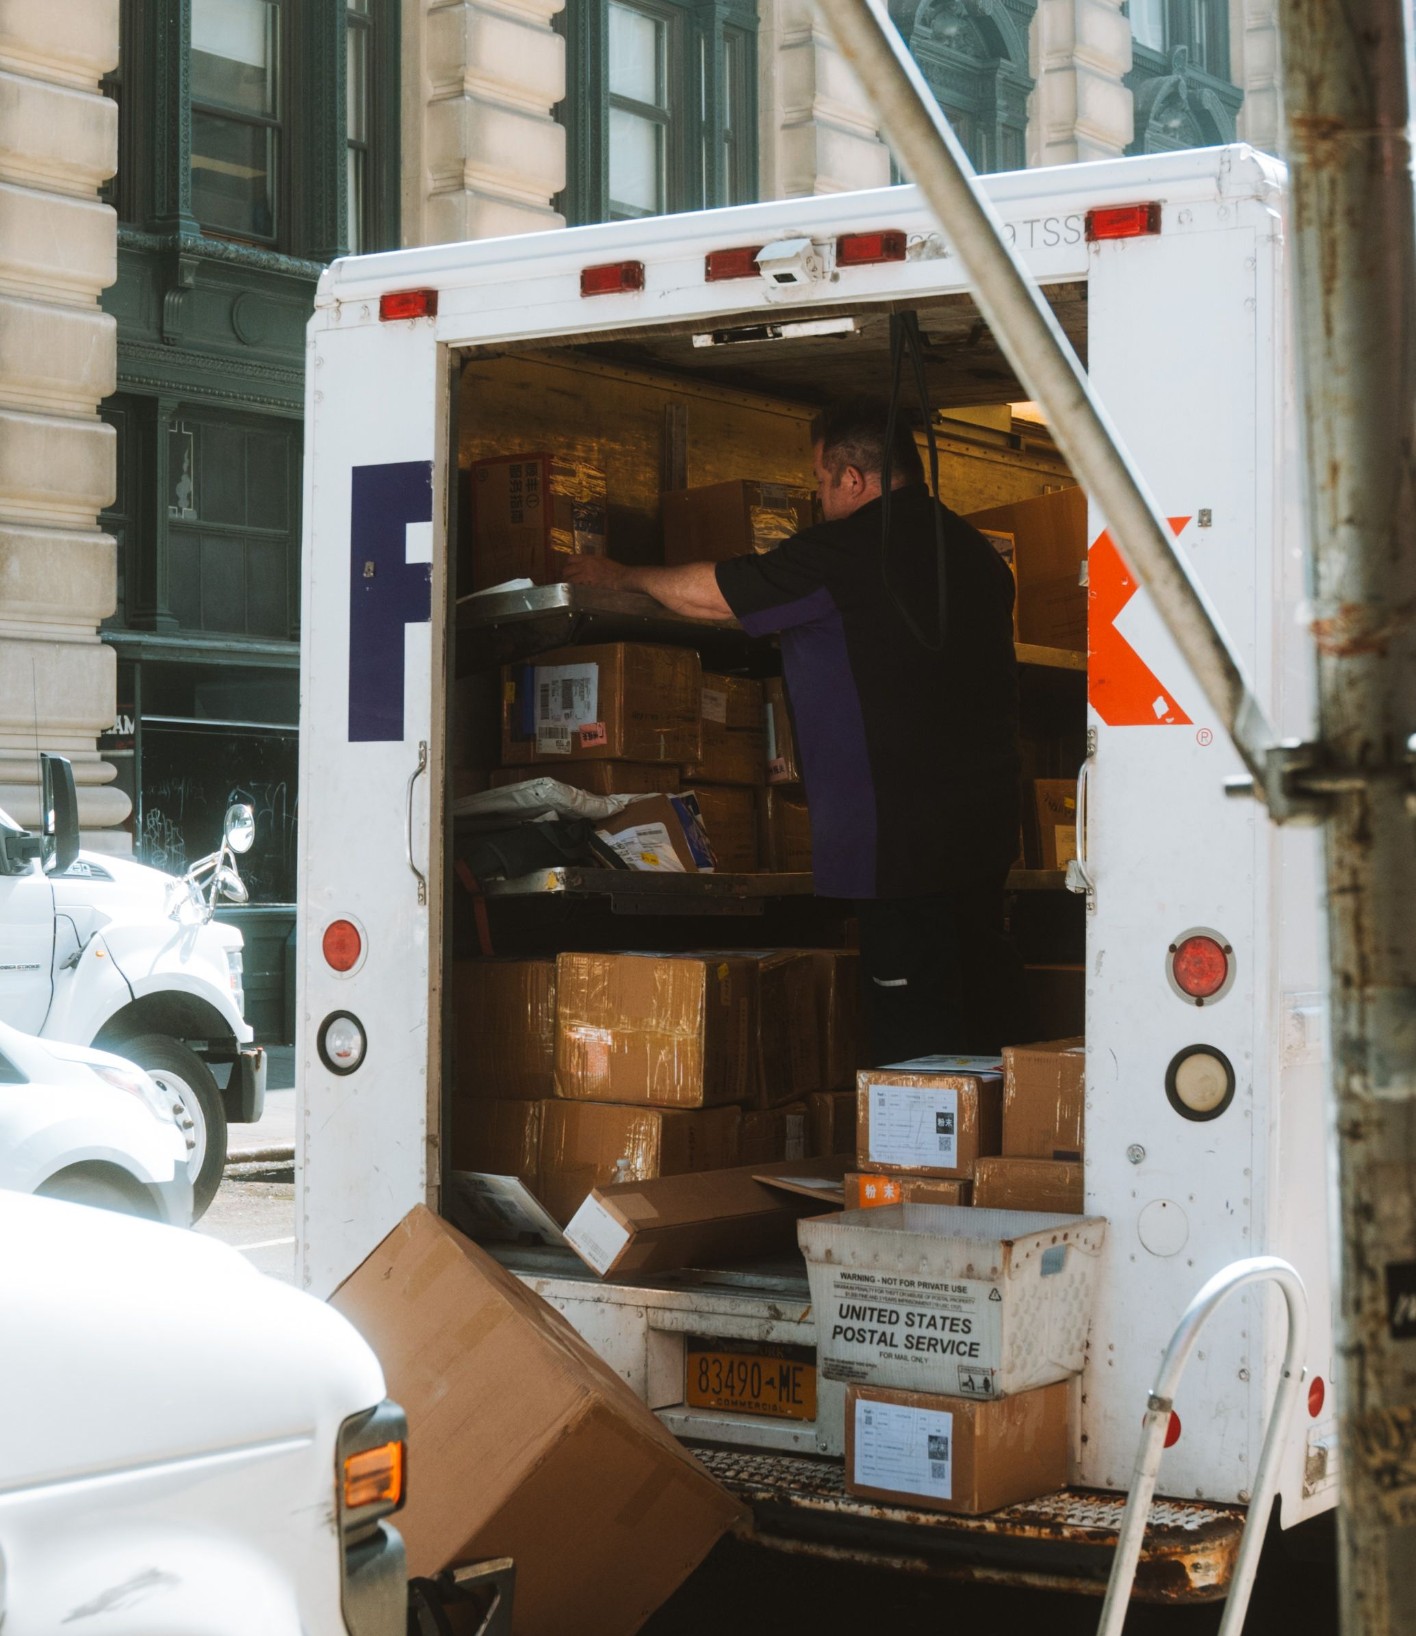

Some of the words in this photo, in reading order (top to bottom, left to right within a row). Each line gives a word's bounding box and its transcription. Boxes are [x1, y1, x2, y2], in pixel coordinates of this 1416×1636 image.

[840, 1271, 875, 1283] WARNING
[881, 1276, 896, 1285] NOT
[899, 1278, 915, 1287] FOR
[917, 1280, 948, 1291] PRIVATE
[951, 1284, 968, 1293] USE
[838, 1303, 900, 1326] UNITED
[905, 1310, 972, 1335] STATES
[832, 1324, 898, 1348] POSTAL
[904, 1332, 980, 1359] SERVICE
[879, 1351, 893, 1359] FOR
[894, 1353, 909, 1361] MAIL
[911, 1355, 928, 1364] ONLY
[698, 1357, 761, 1399] 83490
[779, 1365, 804, 1404] ME
[717, 1399, 786, 1413] COMMERCIAL
